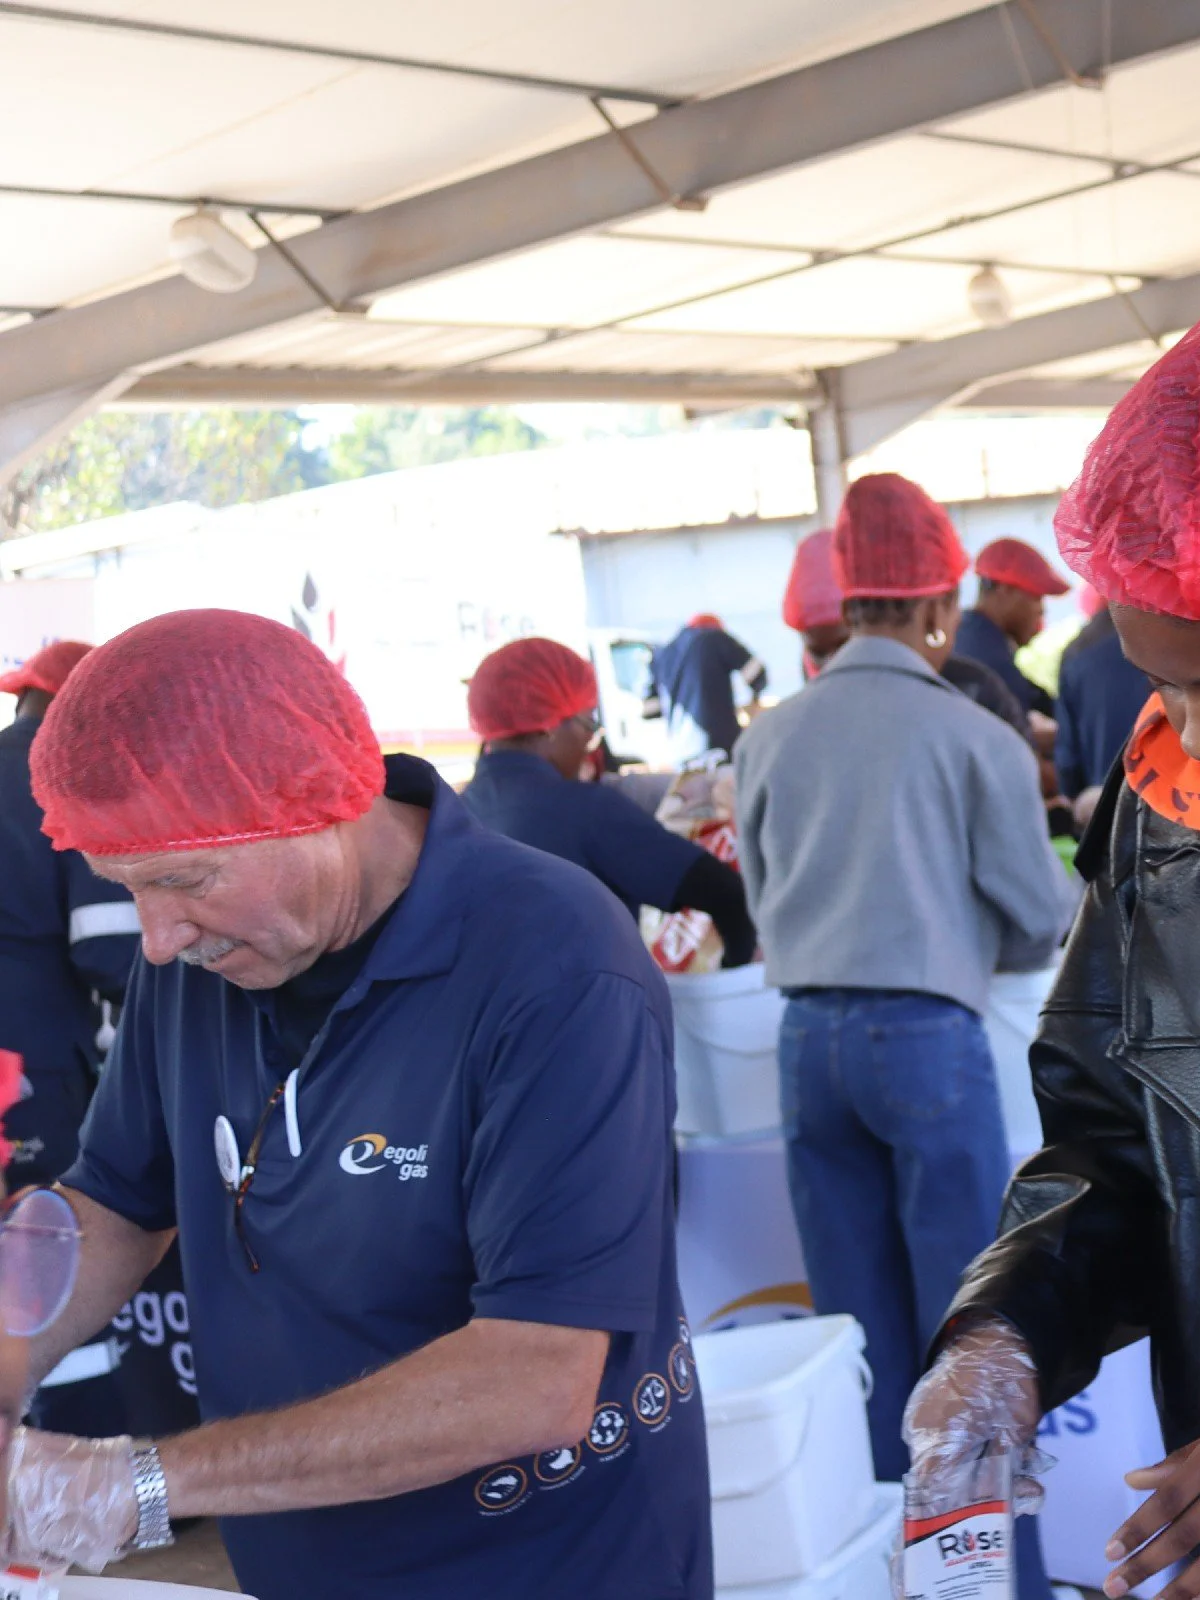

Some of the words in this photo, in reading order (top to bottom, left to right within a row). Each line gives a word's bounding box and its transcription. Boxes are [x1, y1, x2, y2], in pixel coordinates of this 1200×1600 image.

[383, 1144, 428, 1164] egoli
[398, 1163, 428, 1181] gas
[112, 1290, 190, 1347] ego
